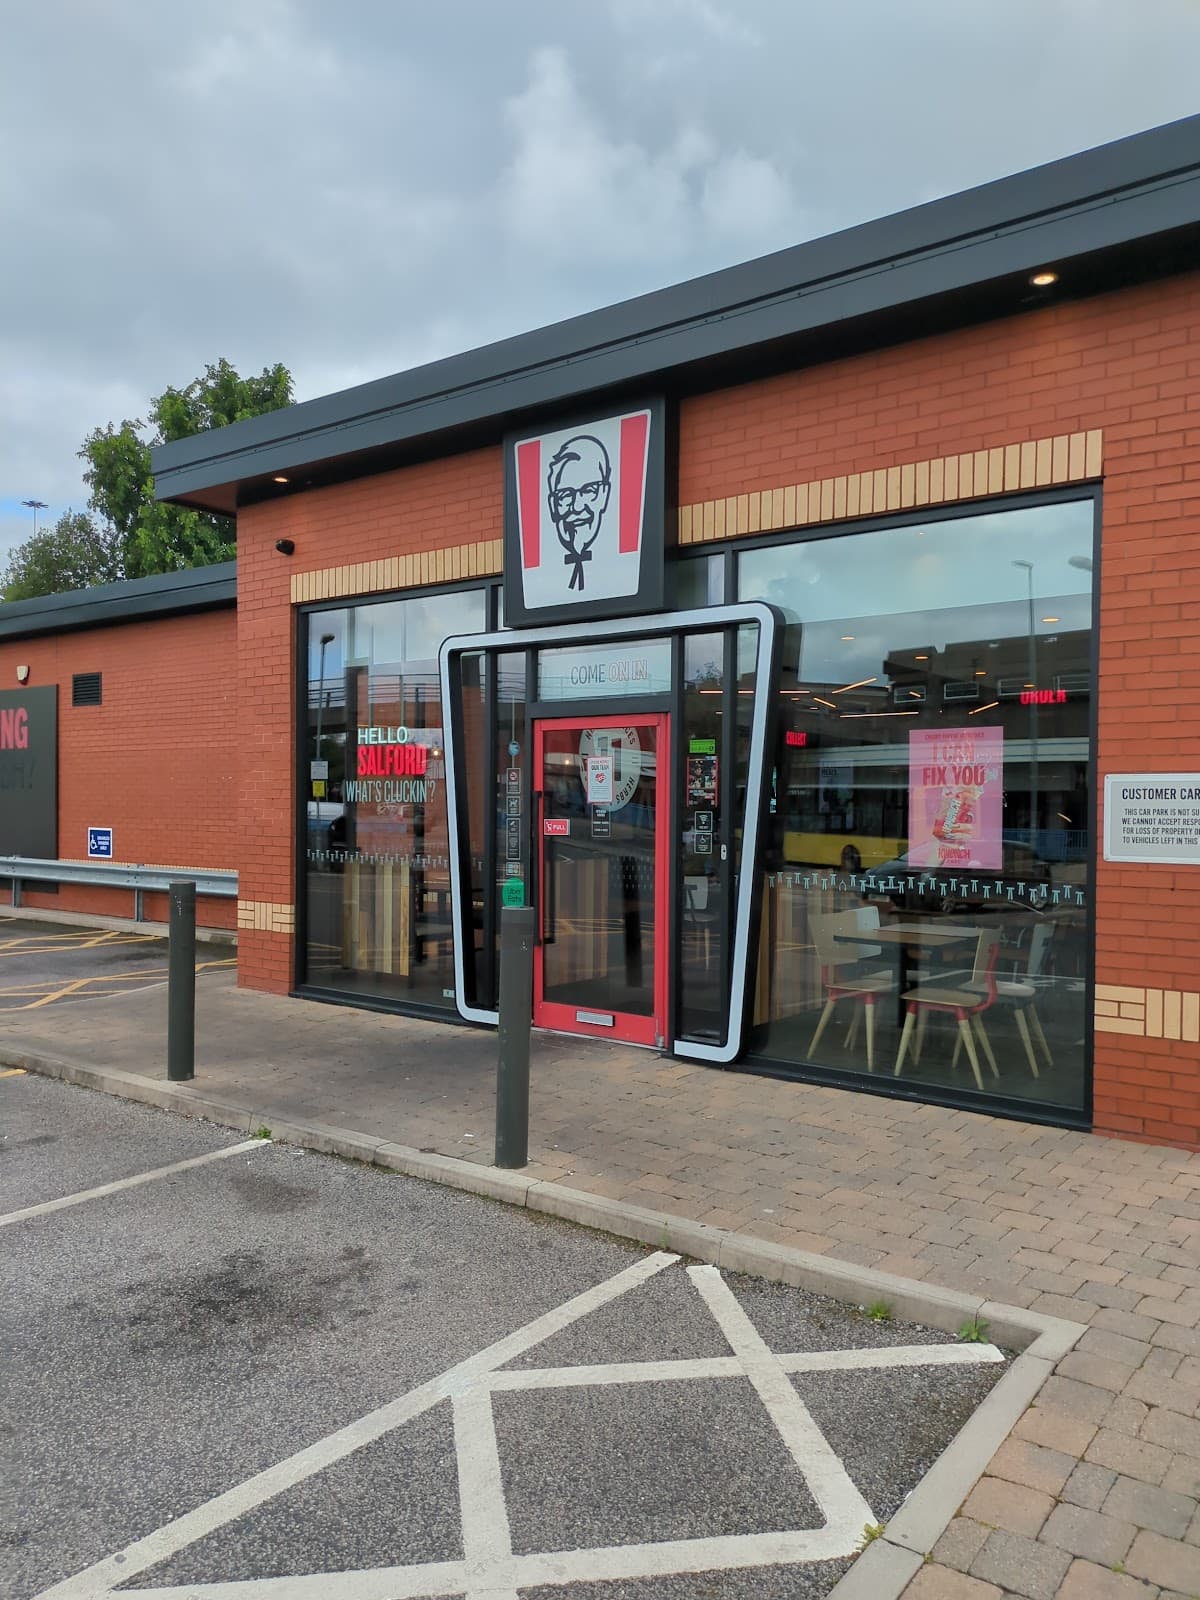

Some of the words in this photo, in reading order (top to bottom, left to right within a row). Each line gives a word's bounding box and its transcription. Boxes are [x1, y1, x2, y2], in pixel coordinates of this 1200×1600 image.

[570, 664, 606, 685] COME
[608, 661, 630, 682] ON
[357, 726, 408, 745] HELLO
[356, 744, 428, 776] SALFORD
[922, 766, 947, 786] FIX
[952, 765, 985, 786] YOU
[346, 780, 382, 802] WHAT'S
[1122, 788, 1176, 800] CUSTOMER
[1180, 788, 1200, 800] CAR
[1125, 808, 1137, 816] THIS
[1139, 808, 1151, 816] CAR
[1152, 808, 1169, 816] PARK
[1170, 808, 1176, 816] IS
[1178, 808, 1190, 816] NOT
[1132, 818, 1156, 826] CANNOT
[1157, 818, 1181, 826] ACCEPT
[1122, 827, 1134, 835] FOR
[1135, 827, 1150, 835] LOSS
[1152, 827, 1160, 835] OF
[1161, 827, 1193, 836] PROPERTY
[1122, 836, 1130, 844] TO
[1132, 836, 1159, 845] VEHICLES
[1161, 836, 1175, 845] LEFT
[1176, 836, 1183, 845] IN
[1184, 837, 1198, 846] THIS
